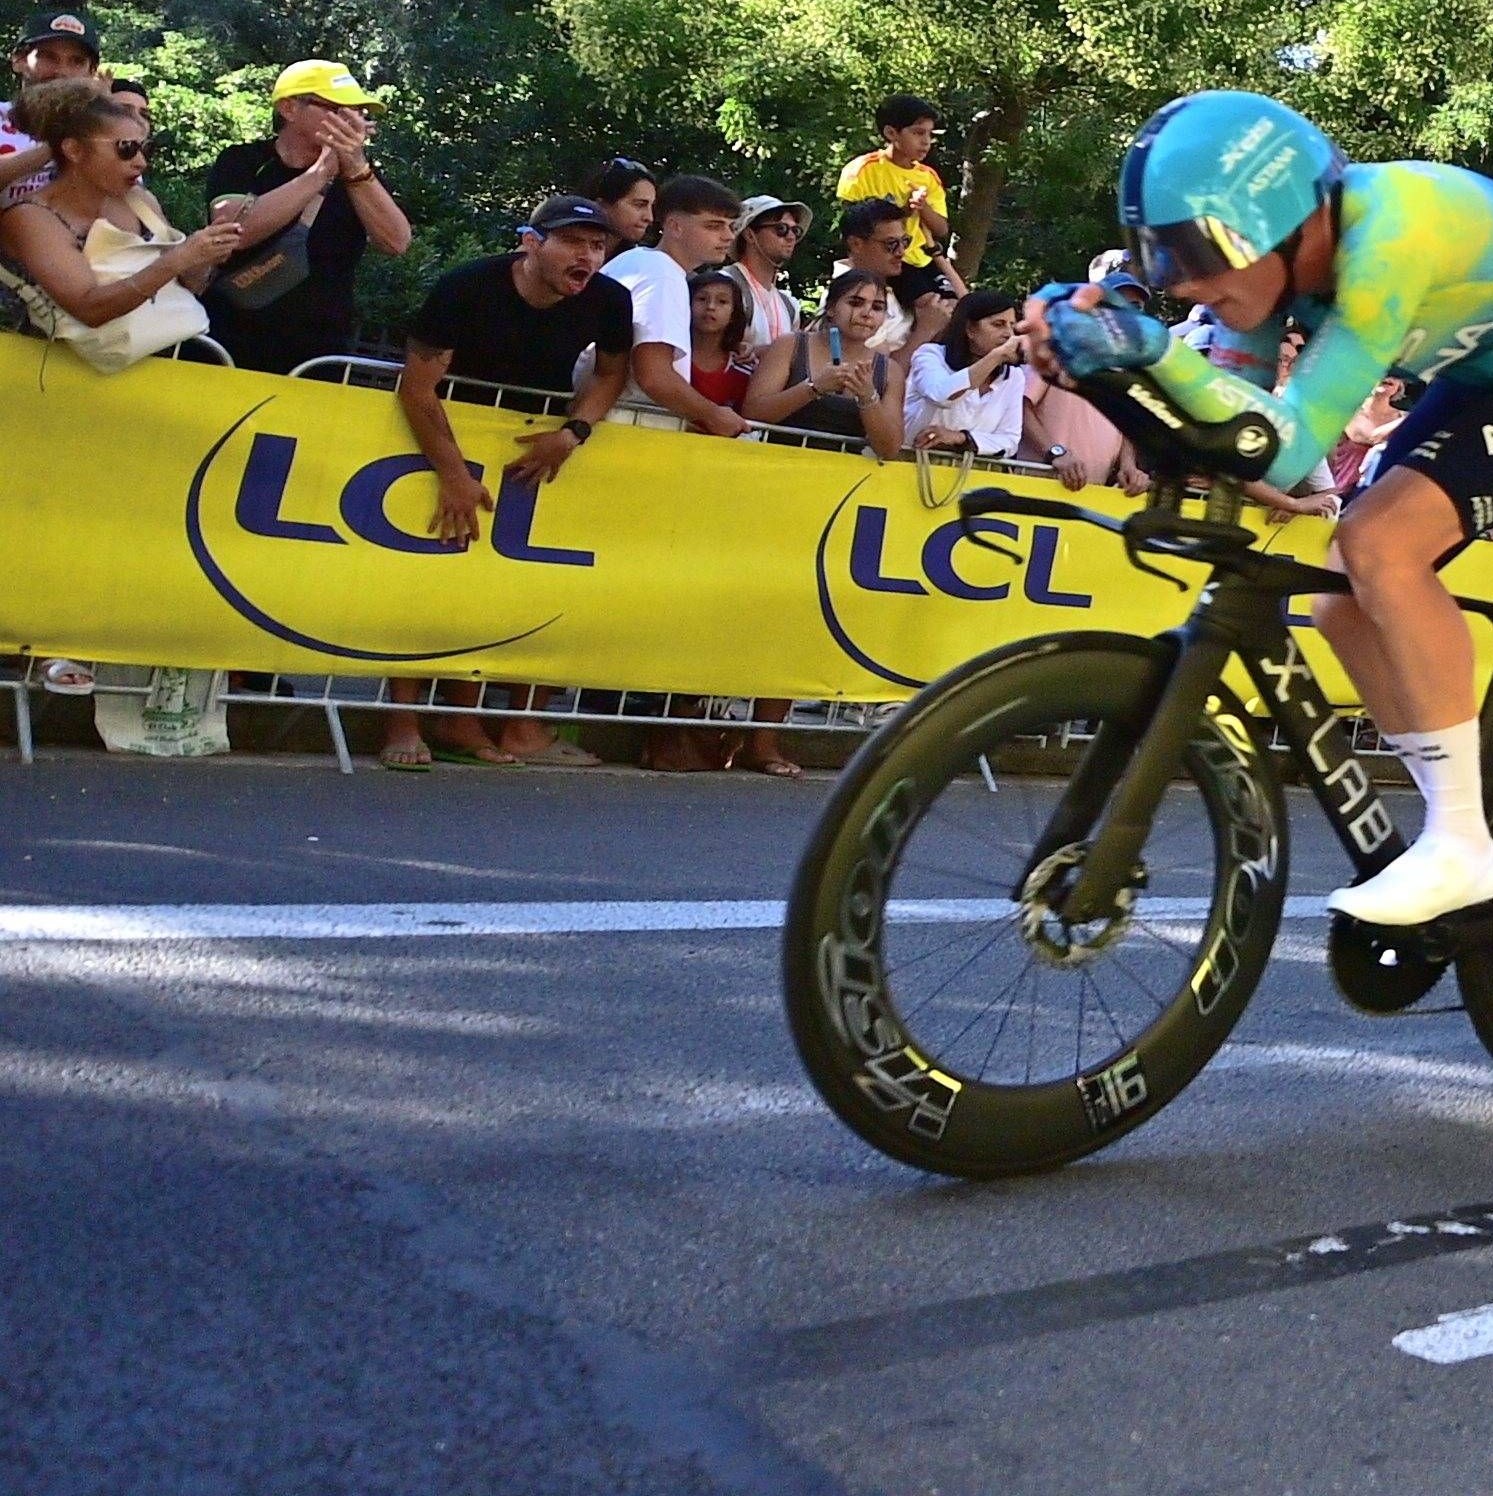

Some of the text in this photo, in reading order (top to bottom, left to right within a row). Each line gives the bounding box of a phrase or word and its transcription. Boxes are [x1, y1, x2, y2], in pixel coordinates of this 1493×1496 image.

[234, 433, 595, 566] LCL
[849, 505, 1092, 608] LCL
[1259, 636, 1393, 855] X-LAB
